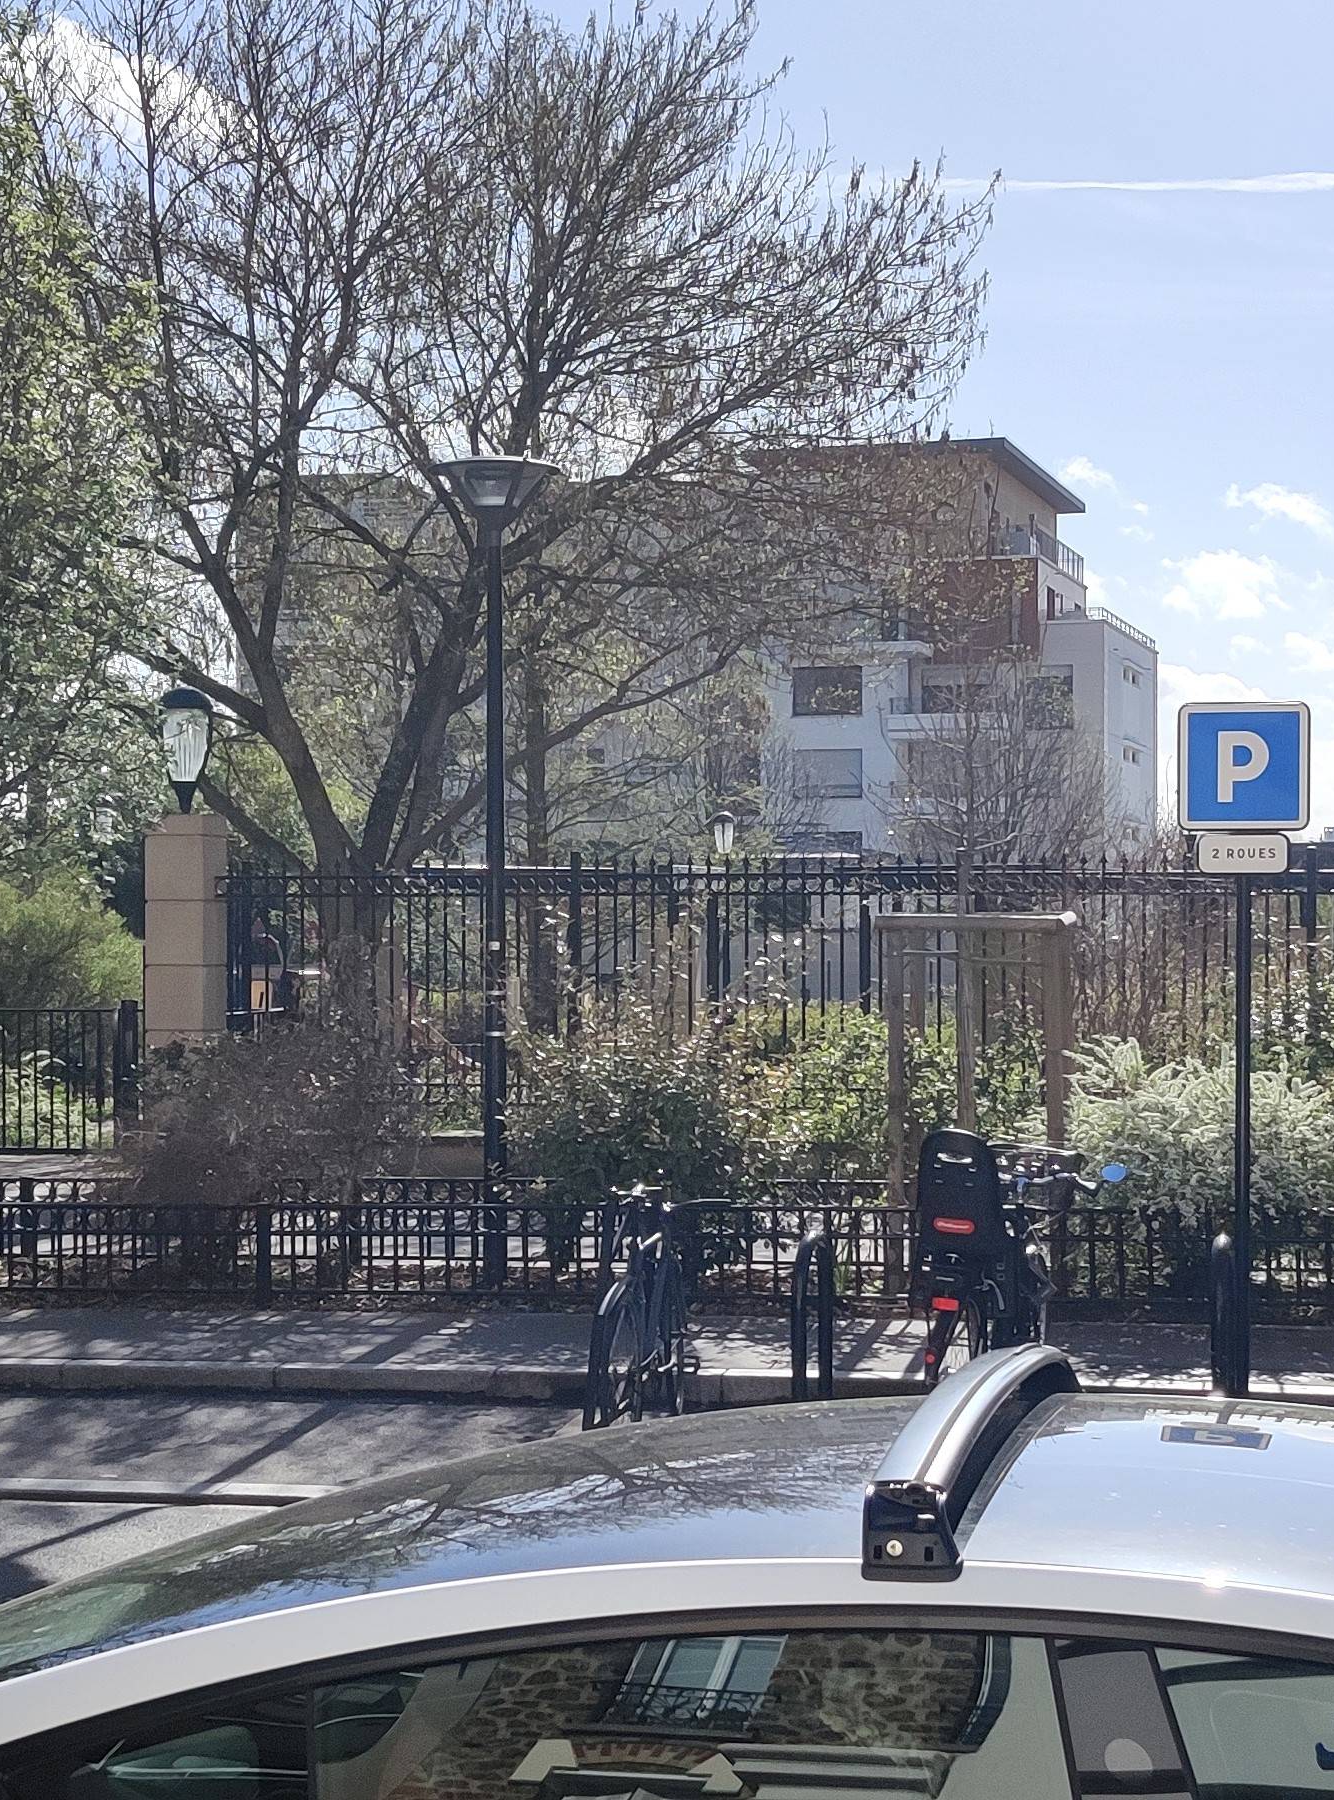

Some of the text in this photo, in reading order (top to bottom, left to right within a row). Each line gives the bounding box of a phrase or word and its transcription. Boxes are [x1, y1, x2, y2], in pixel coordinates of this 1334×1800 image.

[1217, 731, 1270, 803] P
[1211, 848, 1277, 859] 2 ROUES
